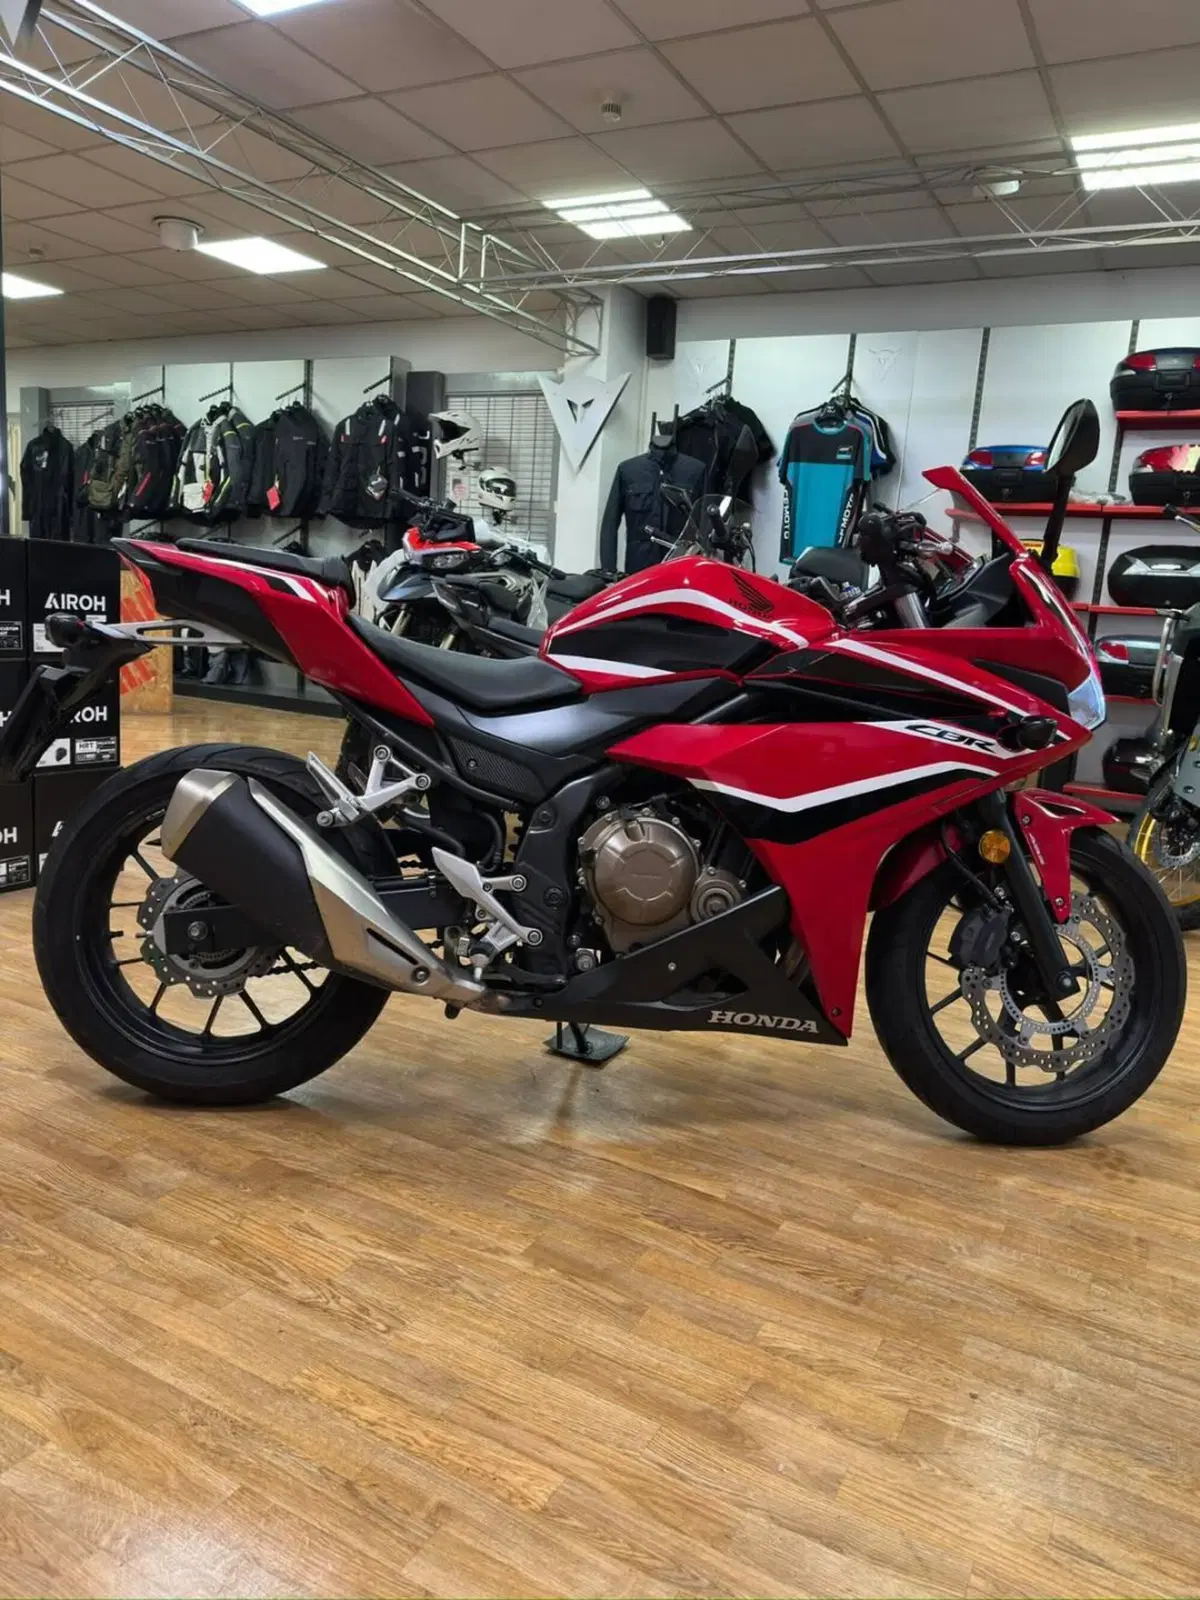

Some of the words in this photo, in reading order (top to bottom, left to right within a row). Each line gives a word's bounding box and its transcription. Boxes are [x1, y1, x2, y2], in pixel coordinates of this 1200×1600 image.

[44, 592, 106, 611] AIROH
[904, 725, 996, 754] CBR
[707, 1010, 819, 1034] HONDA
